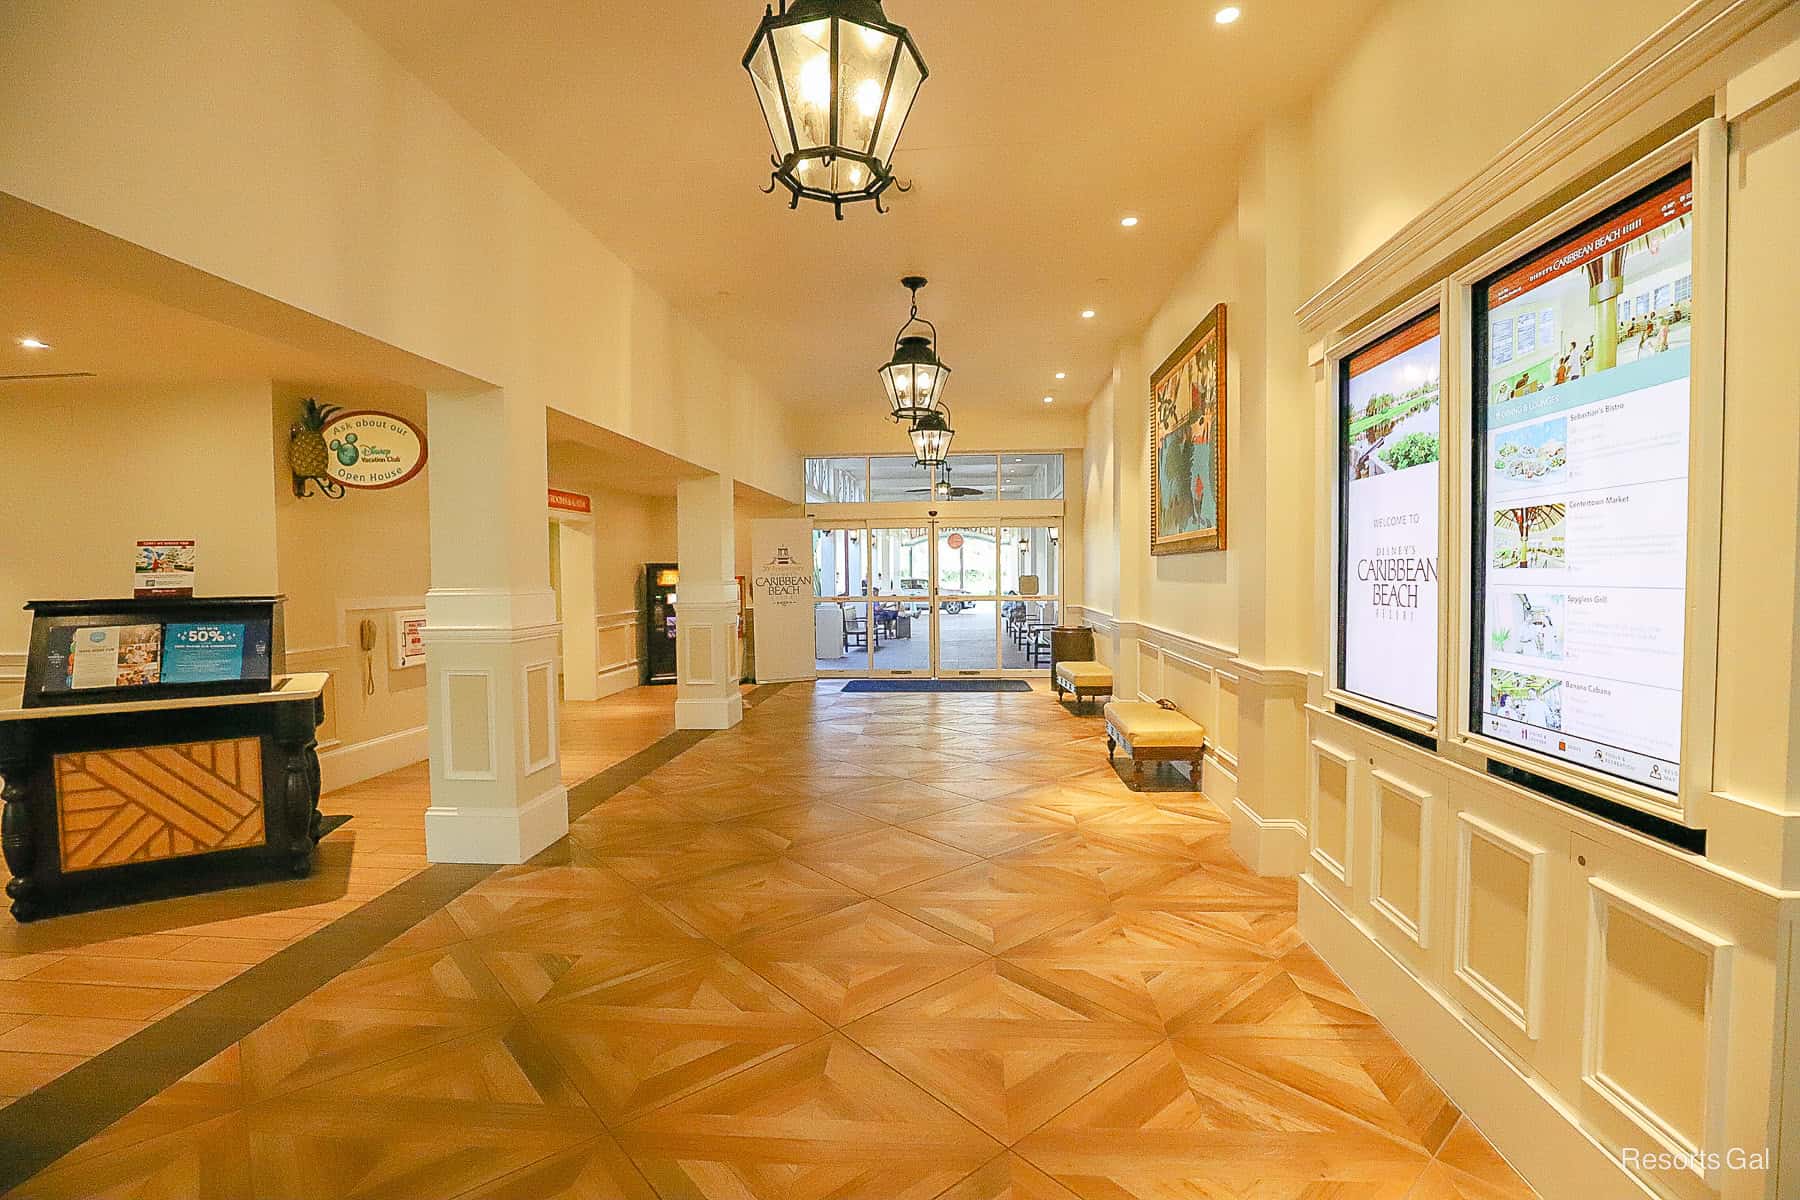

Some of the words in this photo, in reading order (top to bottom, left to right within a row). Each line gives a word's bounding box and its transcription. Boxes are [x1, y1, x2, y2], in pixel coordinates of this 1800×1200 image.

[1553, 242, 1594, 270] CARIBBEAN
[1595, 228, 1621, 250] BEACH
[333, 422, 352, 436] Ask
[355, 419, 387, 432] about
[390, 424, 408, 437] our
[361, 456, 386, 464] Vacation
[338, 468, 366, 482] Open
[370, 467, 402, 482] House
[1373, 514, 1407, 529] WELCOME
[1409, 513, 1420, 525] TO
[1357, 557, 1438, 582] CARIBBEAN
[755, 576, 812, 587] CARIBBEAN
[768, 586, 800, 596] BEACH
[1373, 583, 1418, 608] BEACH
[188, 630, 225, 642] 50%
